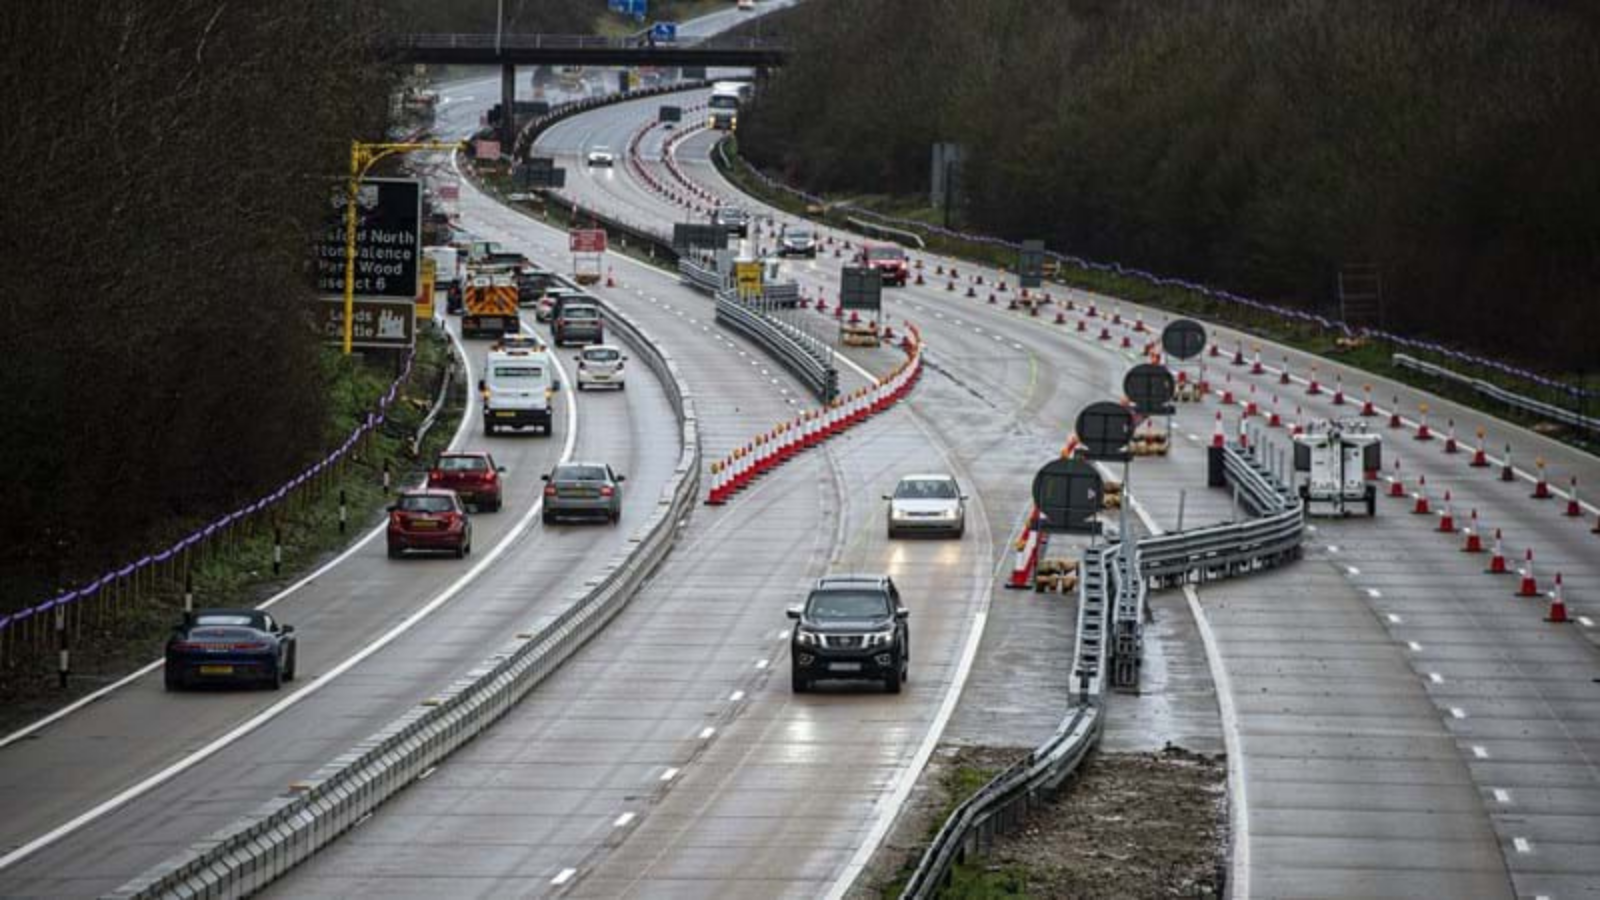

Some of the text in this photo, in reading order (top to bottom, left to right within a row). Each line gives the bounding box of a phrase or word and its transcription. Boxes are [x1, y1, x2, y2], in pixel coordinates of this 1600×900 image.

[371, 230, 415, 245] North
[357, 261, 403, 275] Wood
[354, 278, 371, 289] ct
[375, 276, 386, 290] 6
[325, 322, 374, 336] Catle
